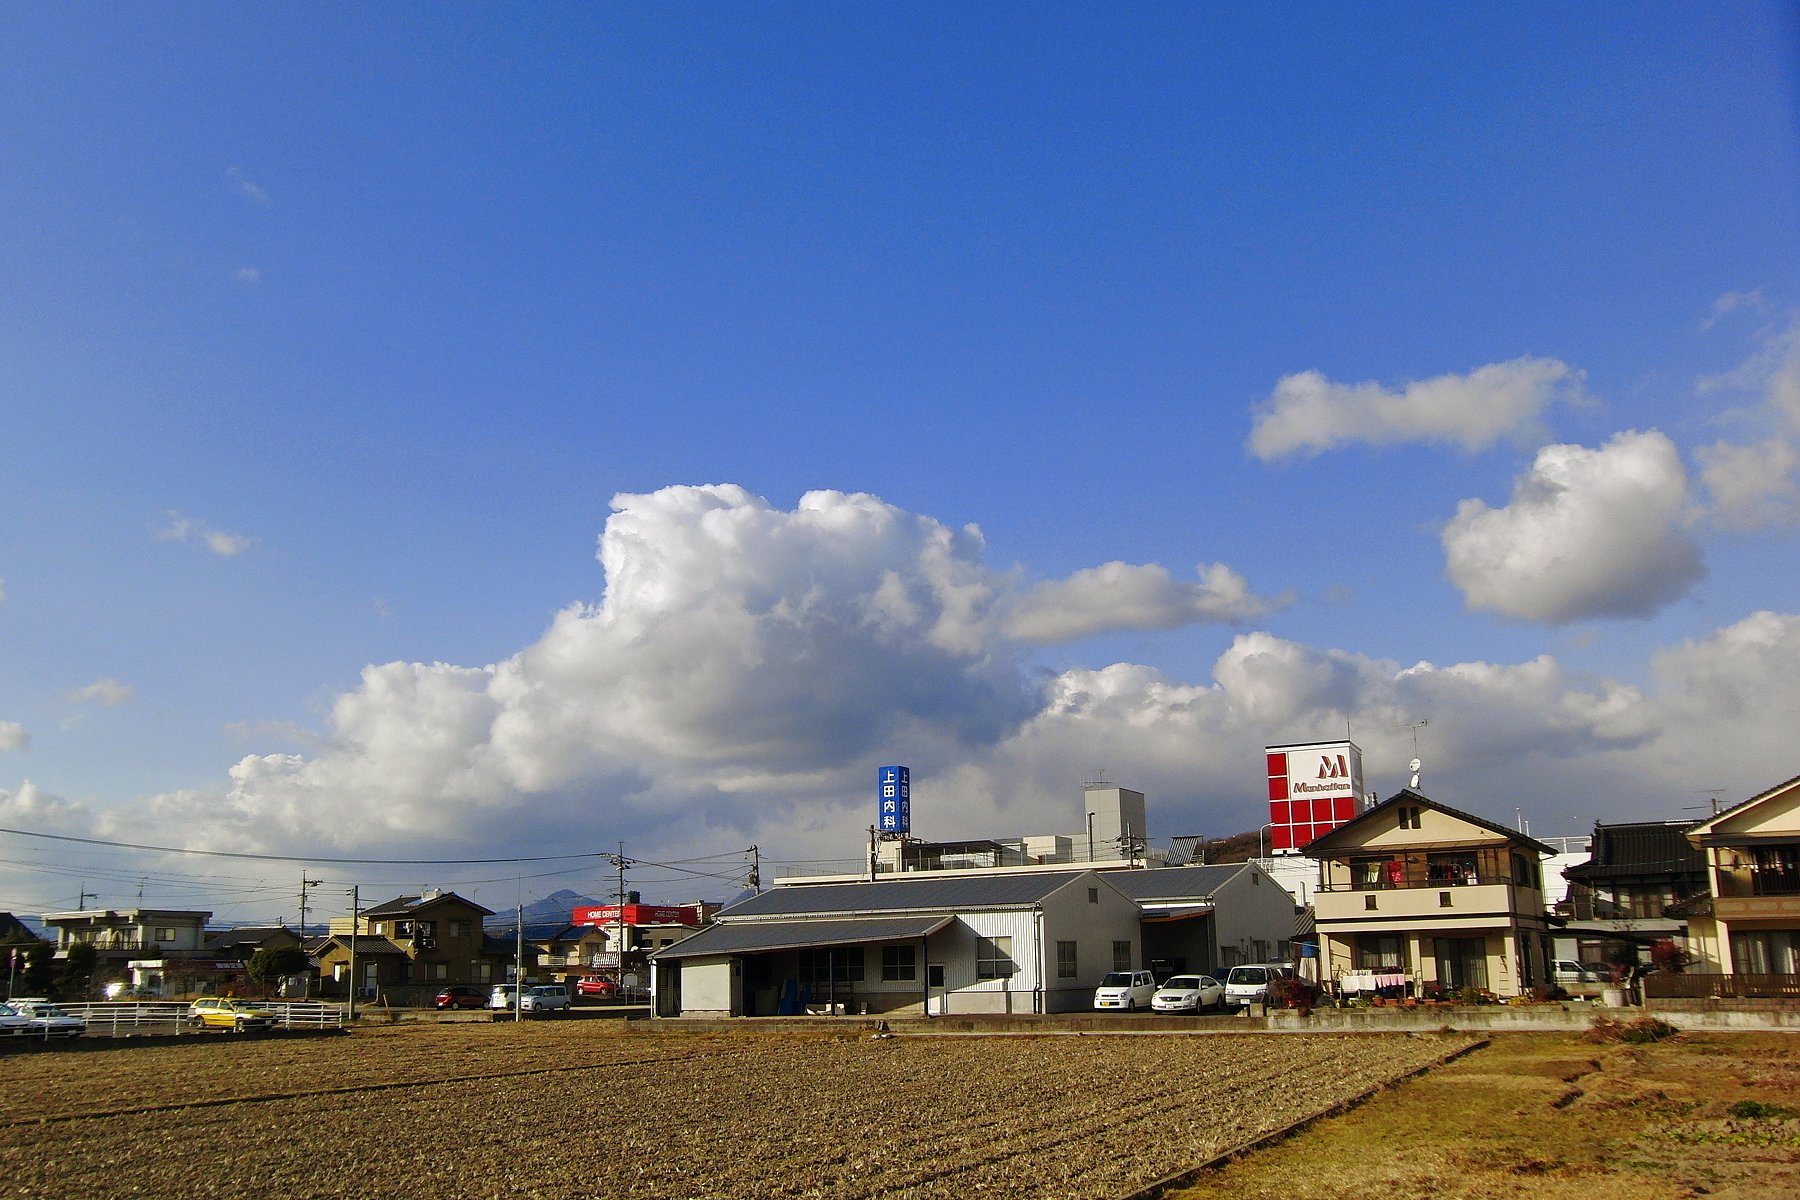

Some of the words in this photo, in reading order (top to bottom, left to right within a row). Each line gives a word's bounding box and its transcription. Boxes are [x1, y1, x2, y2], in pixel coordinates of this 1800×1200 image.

[883, 770, 896, 828] 上田内科
[1293, 782, 1351, 793] Manhattan
